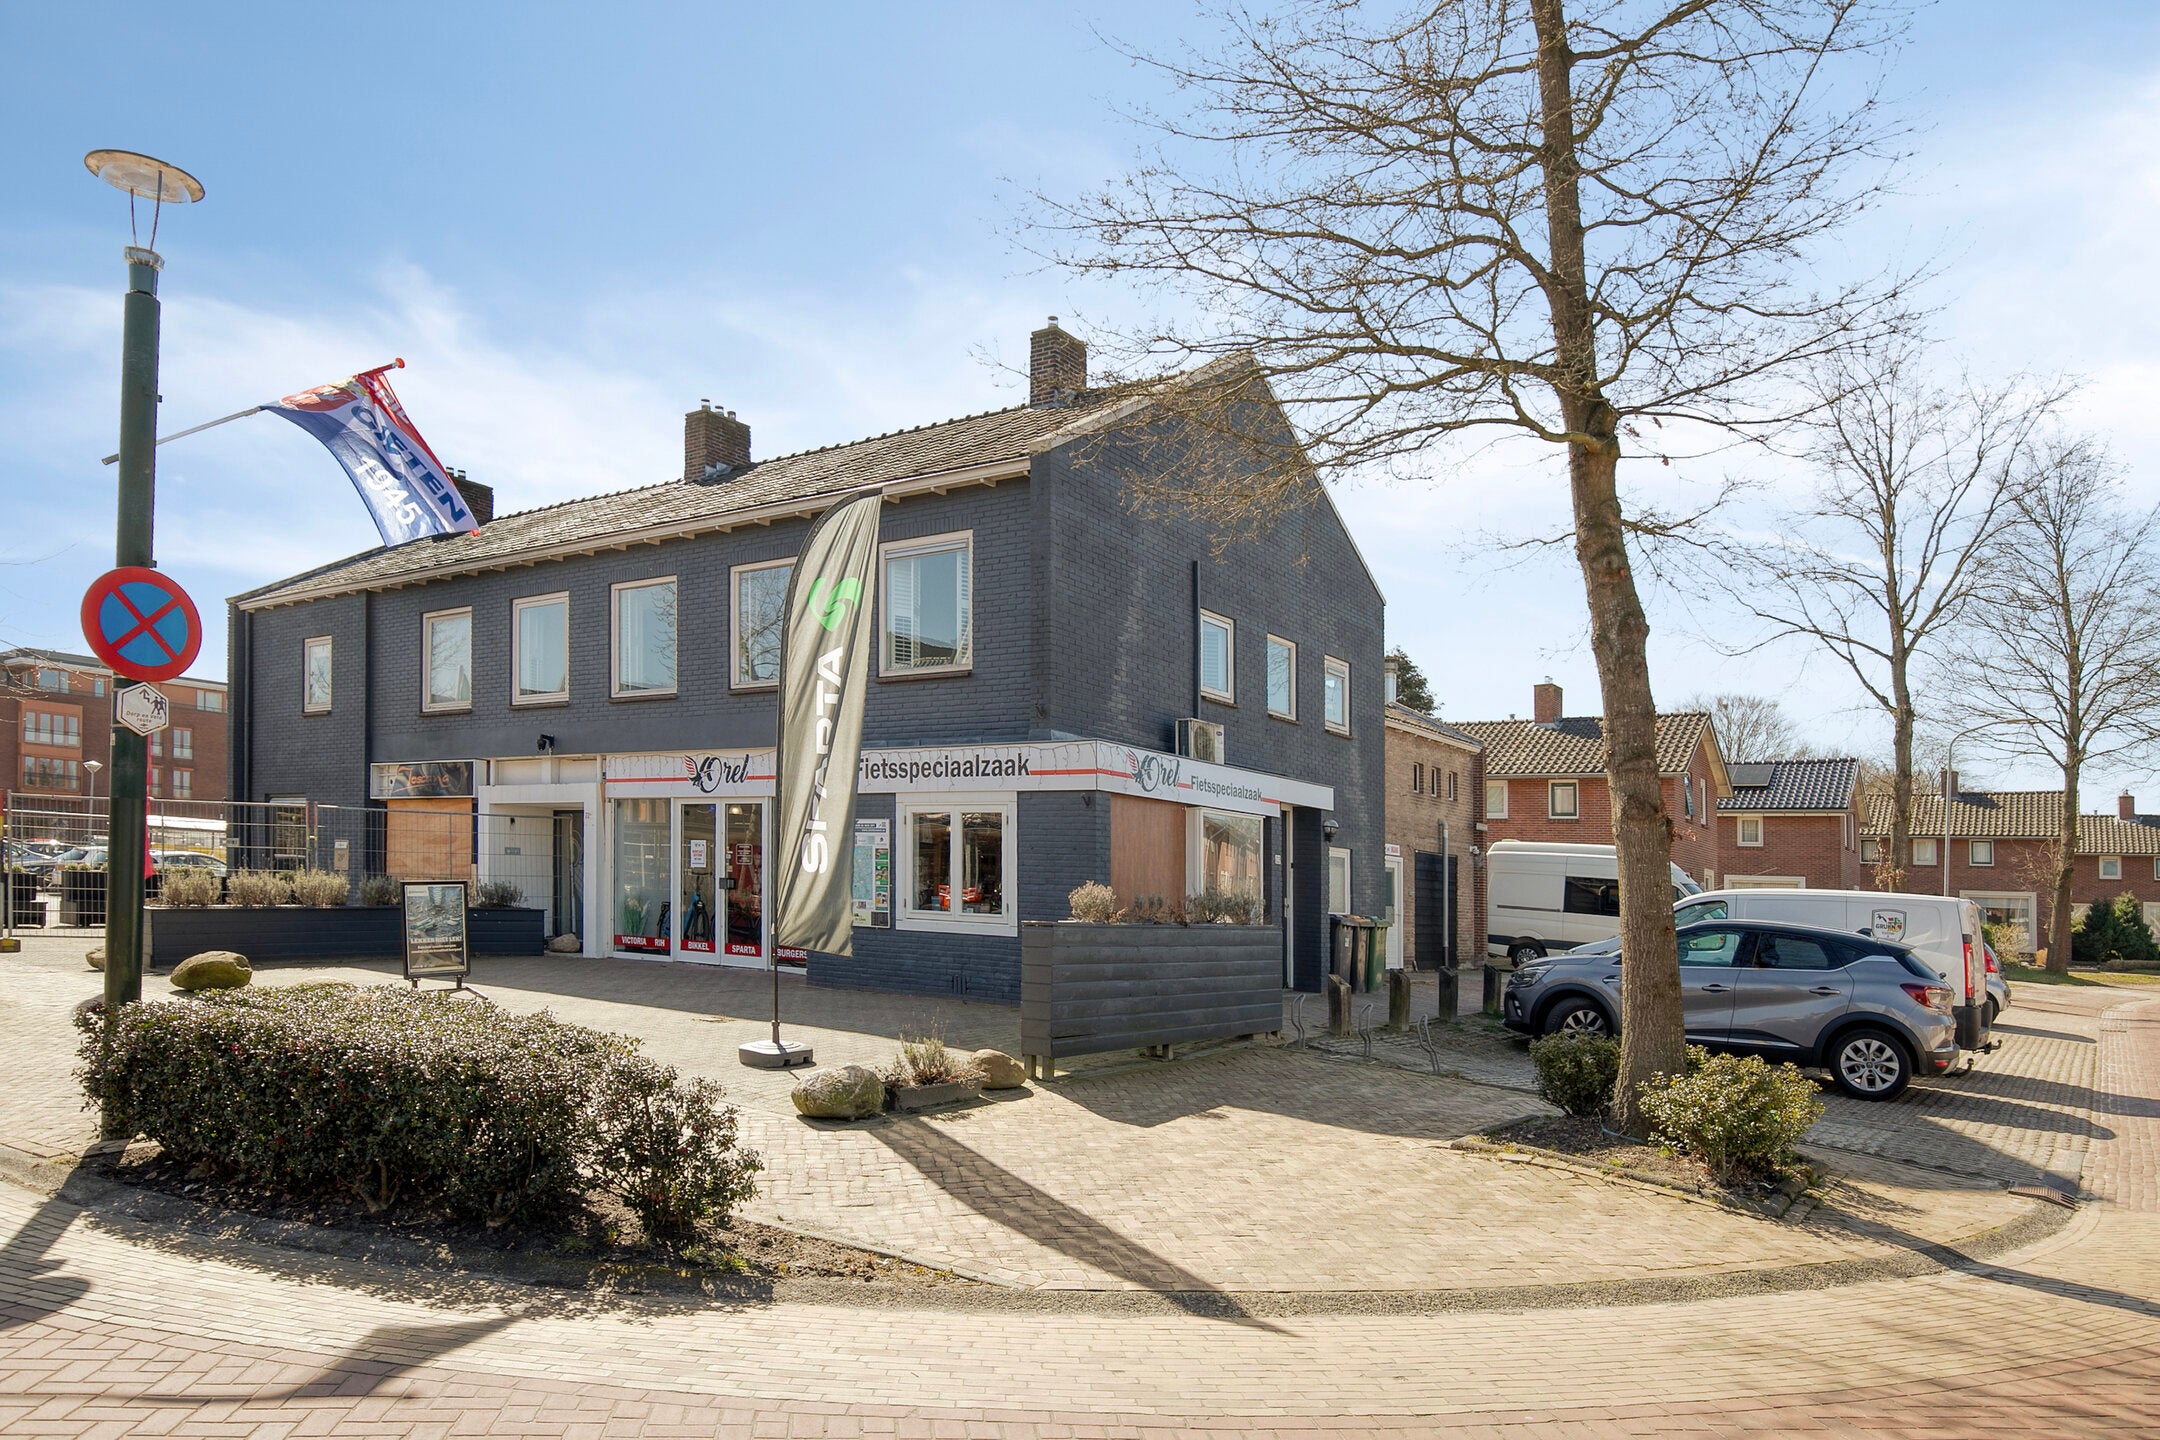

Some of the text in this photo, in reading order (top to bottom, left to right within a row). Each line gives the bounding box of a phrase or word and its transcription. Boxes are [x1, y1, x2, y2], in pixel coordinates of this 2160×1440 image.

[355, 457, 424, 525] 1945
[700, 754, 749, 793] Orel
[1140, 754, 1263, 801] Orel Fietsspeciaalzaak
[621, 935, 666, 947] VICTORIA RIH
[688, 941, 710, 951] BIKKEL
[731, 945, 757, 955] SPARTA
